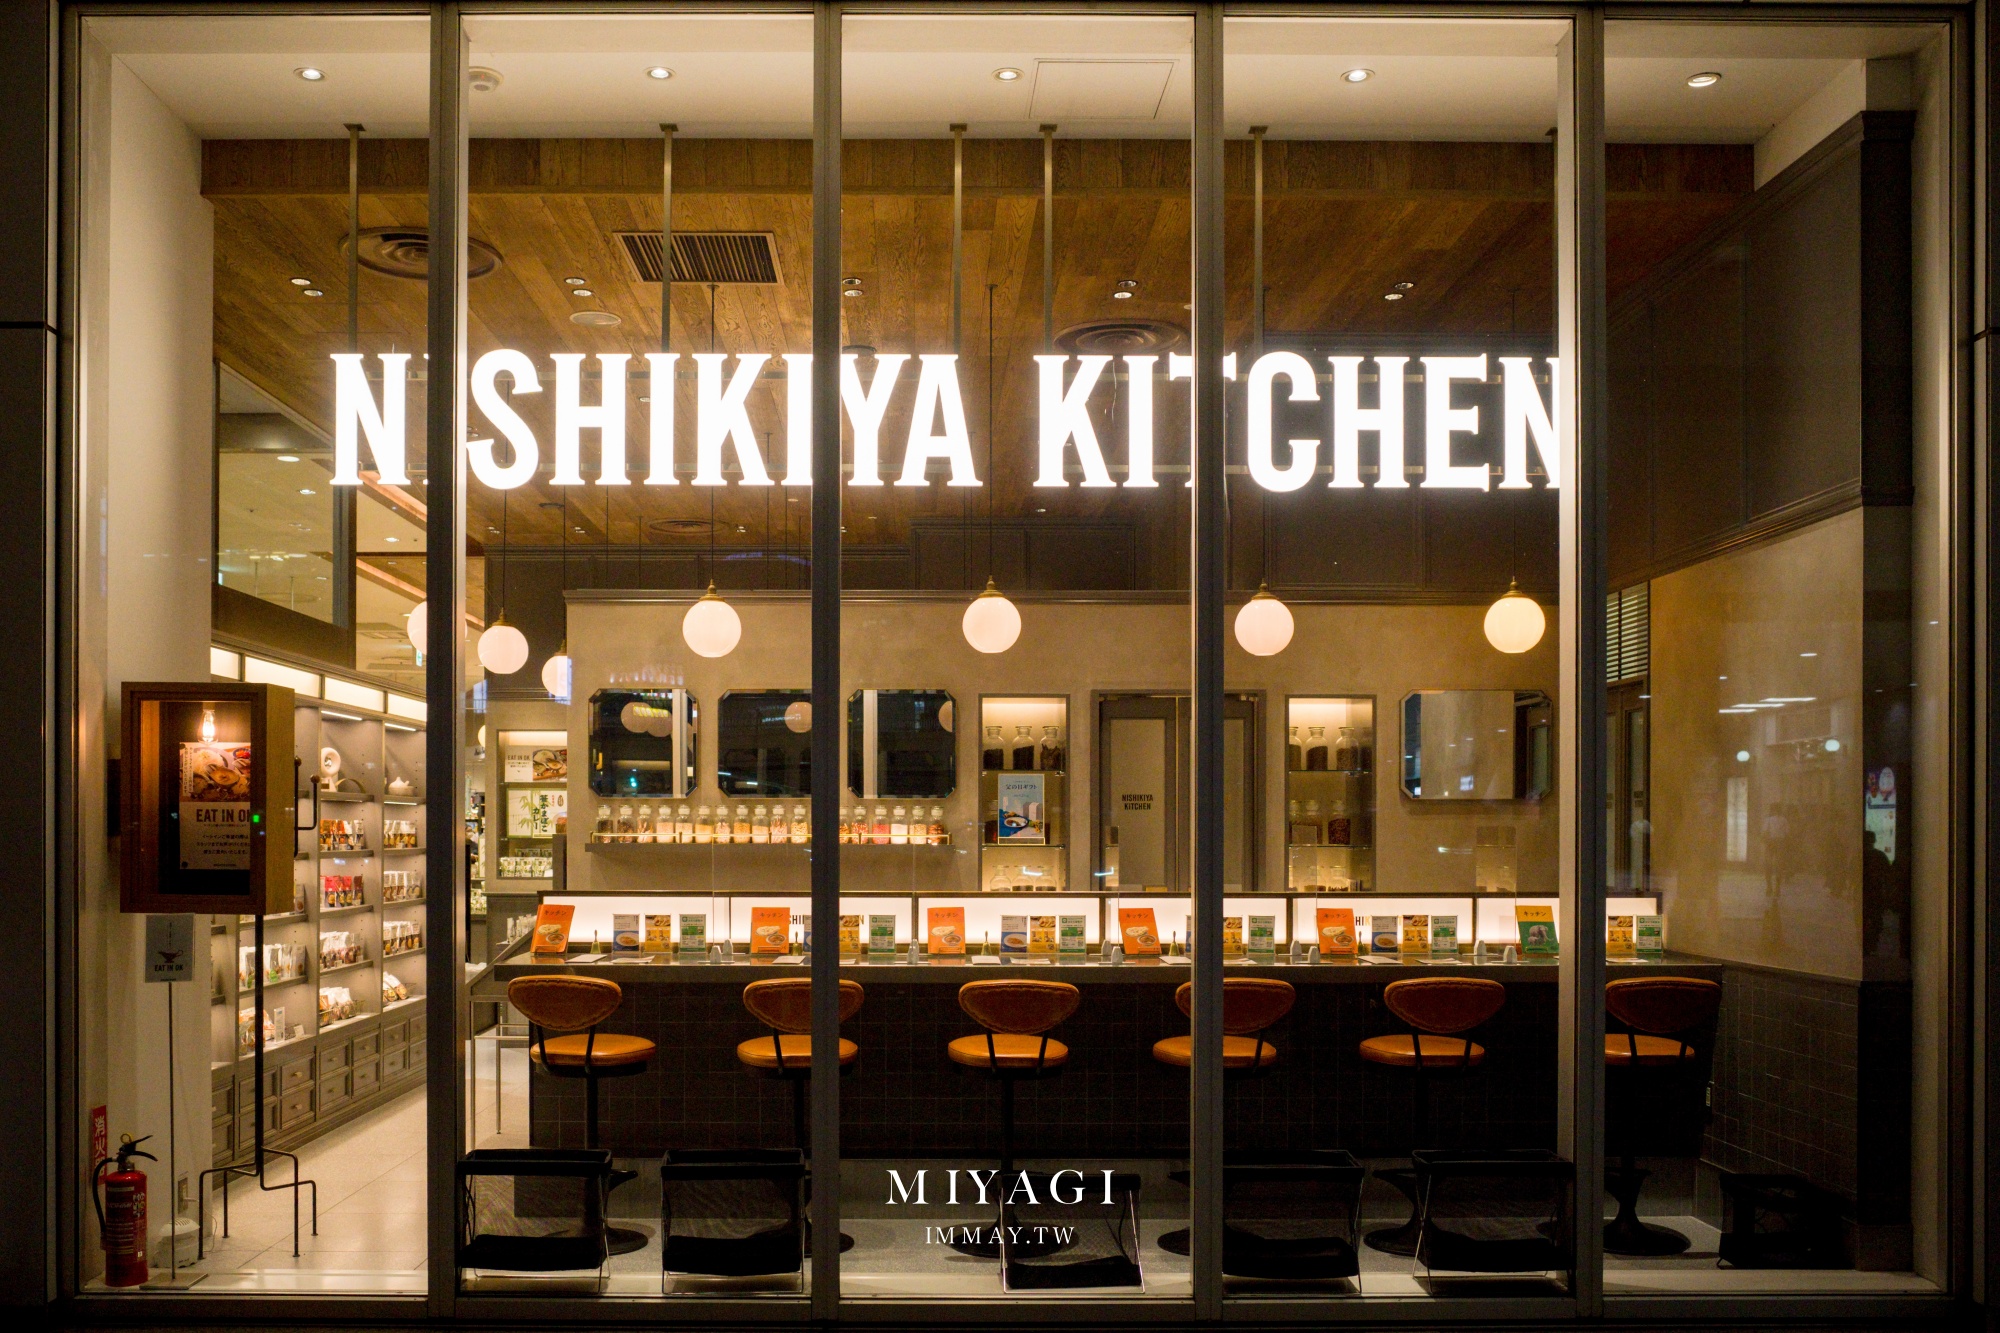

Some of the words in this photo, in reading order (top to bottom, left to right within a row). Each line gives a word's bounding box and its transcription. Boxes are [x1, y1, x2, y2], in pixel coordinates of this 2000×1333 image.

[330, 348, 983, 490] NSHIKIYA
[1121, 794, 1154, 802] NISHIKIYA
[196, 808, 218, 823] EAT
[221, 808, 234, 823] IN
[154, 964, 165, 972] EAT
[166, 964, 174, 972] IN
[175, 964, 184, 972] OK
